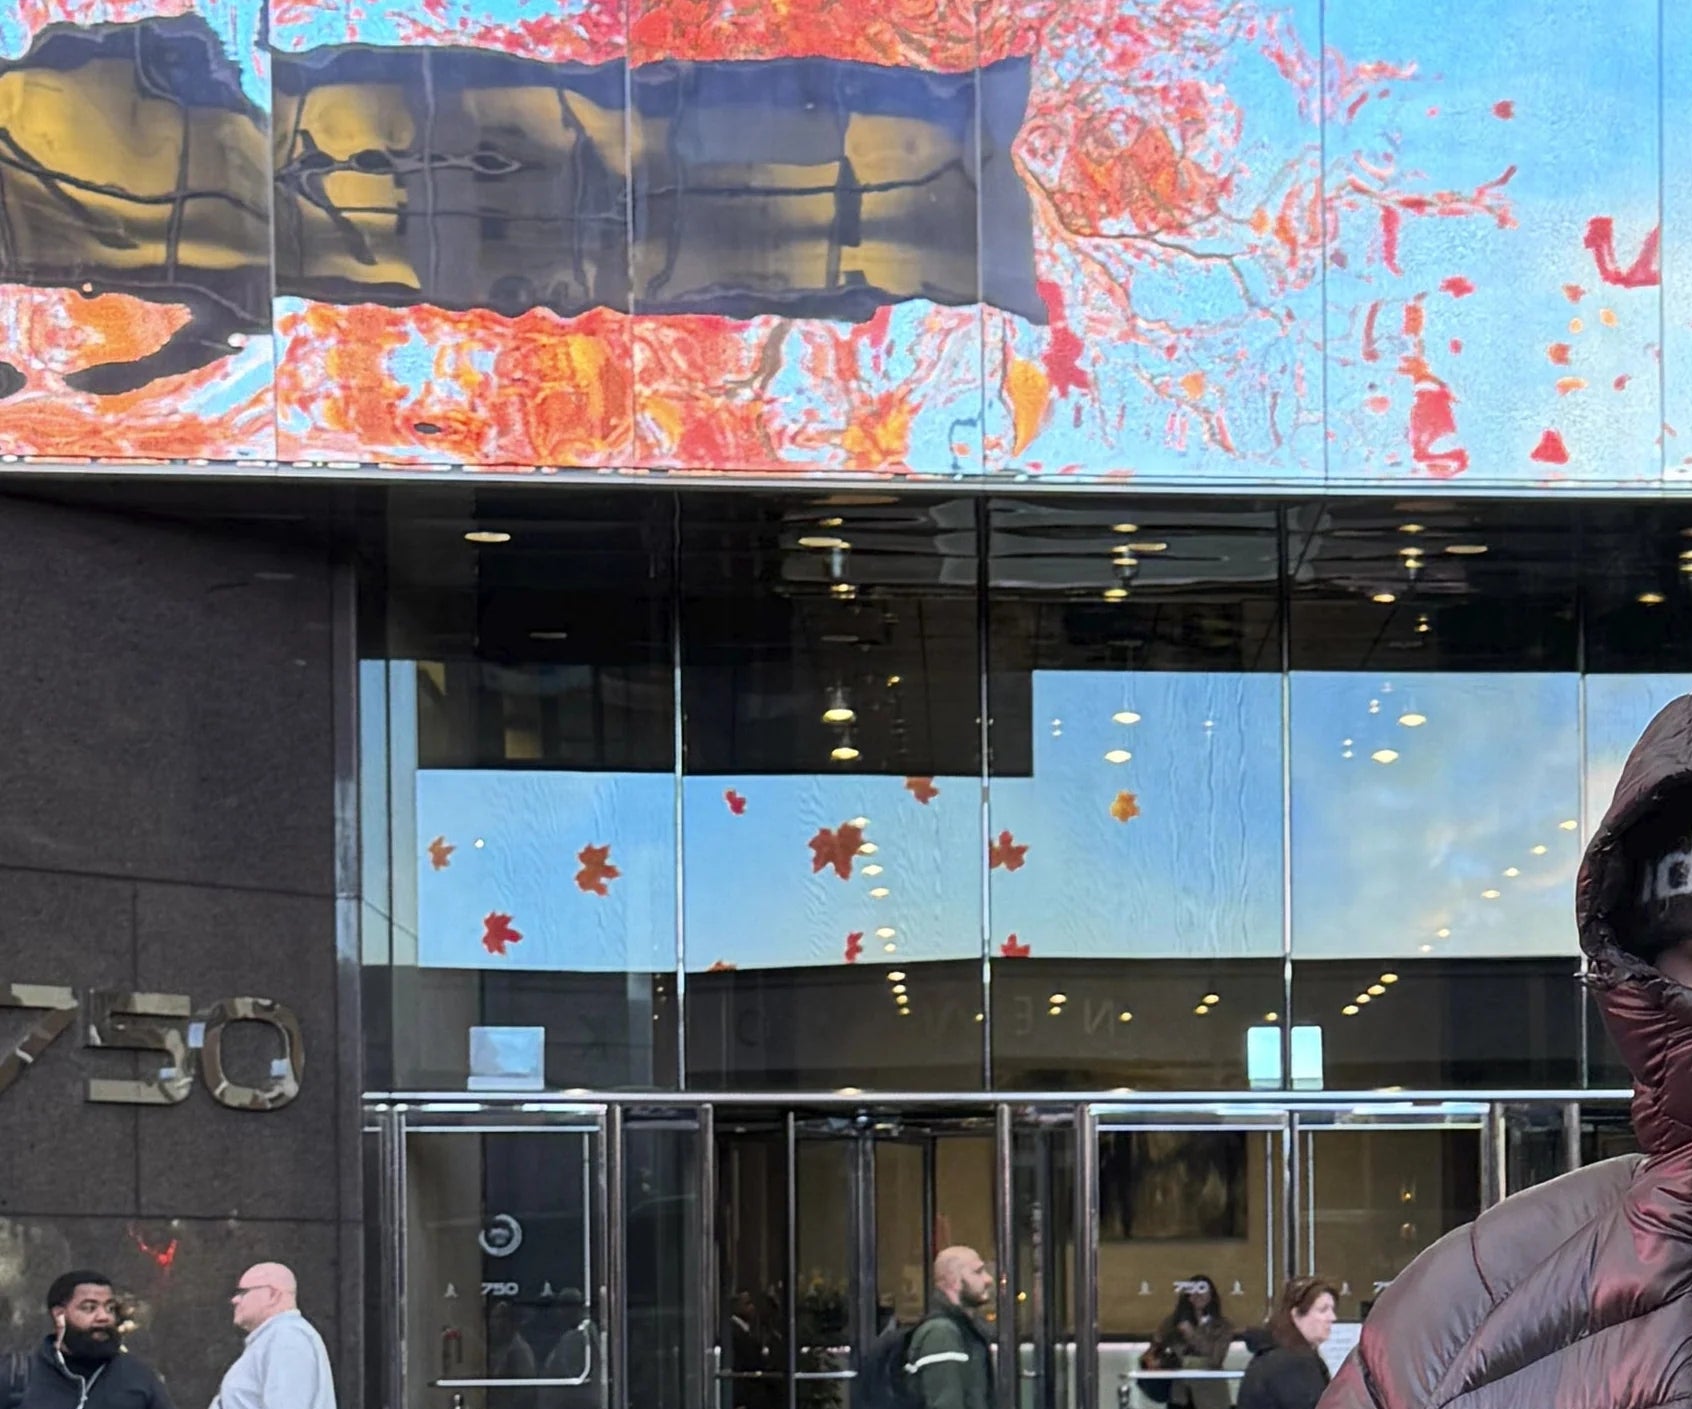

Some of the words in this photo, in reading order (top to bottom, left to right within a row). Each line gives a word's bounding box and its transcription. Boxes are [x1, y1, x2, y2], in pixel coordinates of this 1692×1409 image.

[0, 982, 305, 1112] 750
[480, 1281, 520, 1296] 750
[1172, 1279, 1210, 1295] 750
